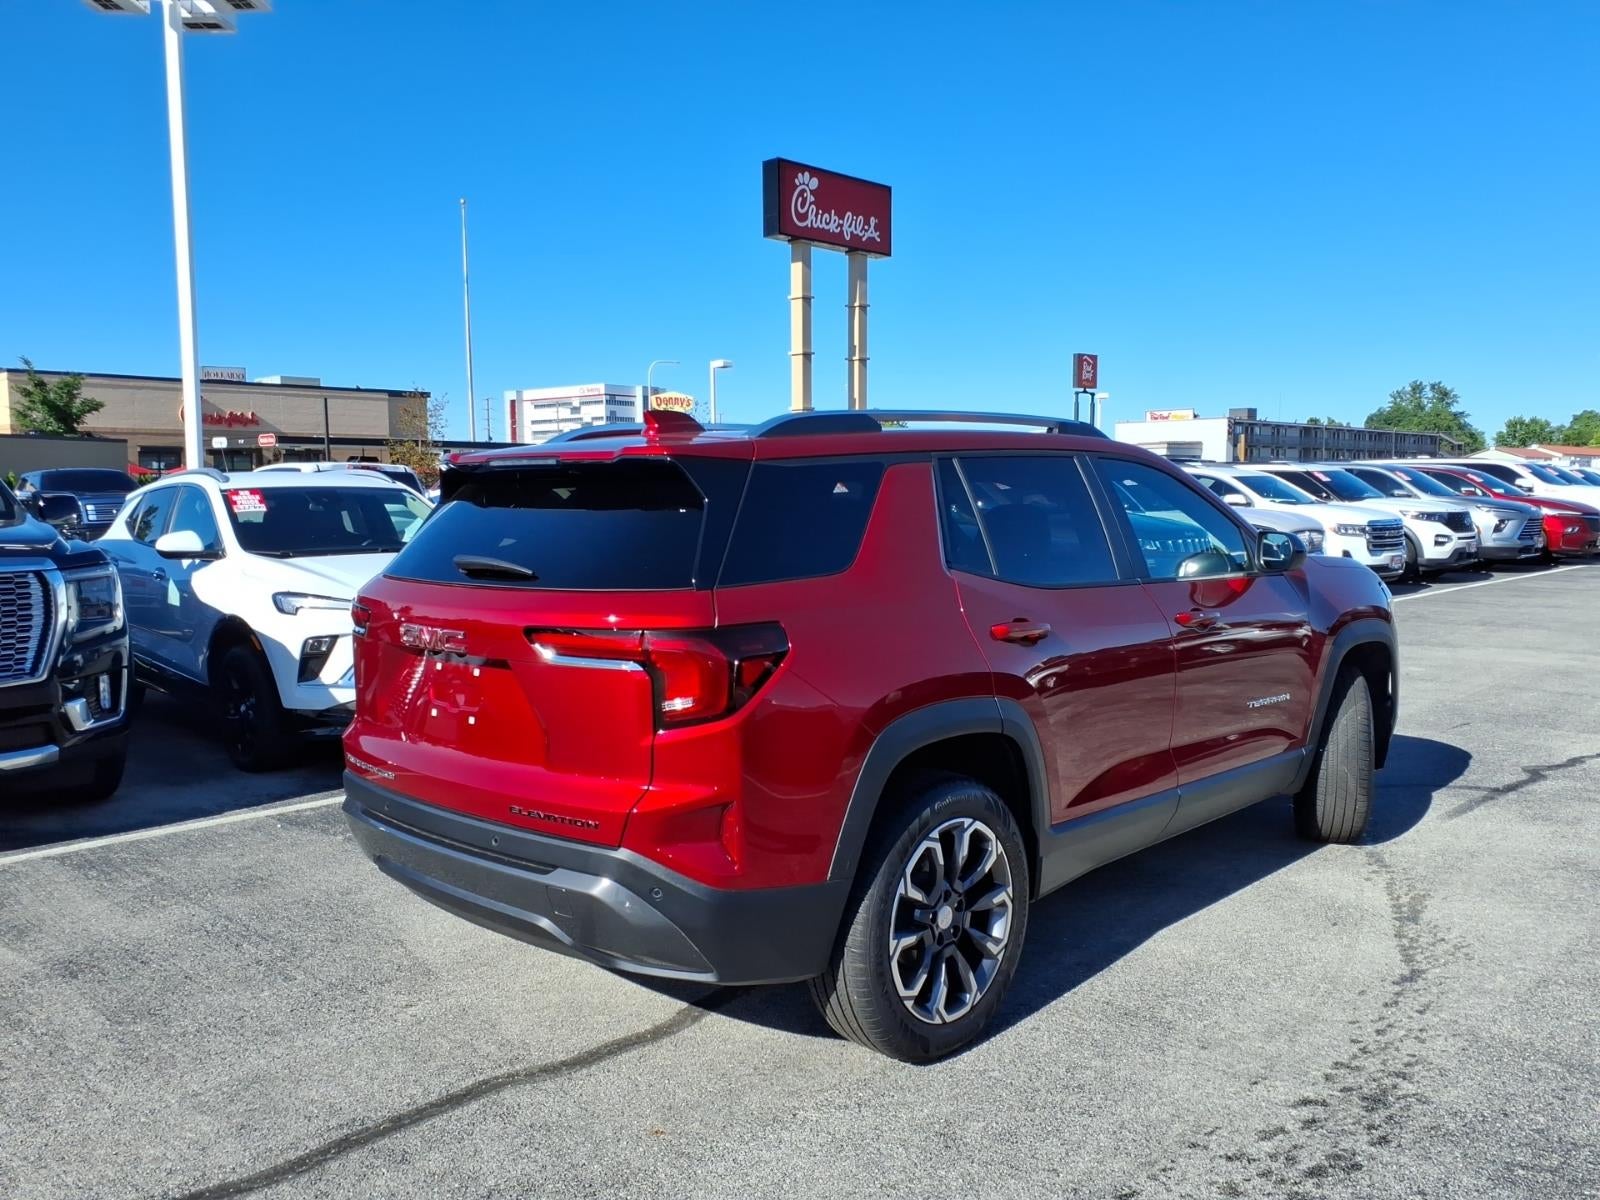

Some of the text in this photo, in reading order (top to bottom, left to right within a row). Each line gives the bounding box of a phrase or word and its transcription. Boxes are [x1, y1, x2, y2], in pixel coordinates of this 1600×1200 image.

[791, 182, 881, 242] Chick-fil-A
[655, 395, 692, 408] Denny's
[399, 623, 465, 653] GMC
[509, 805, 600, 829] ELEVATION
